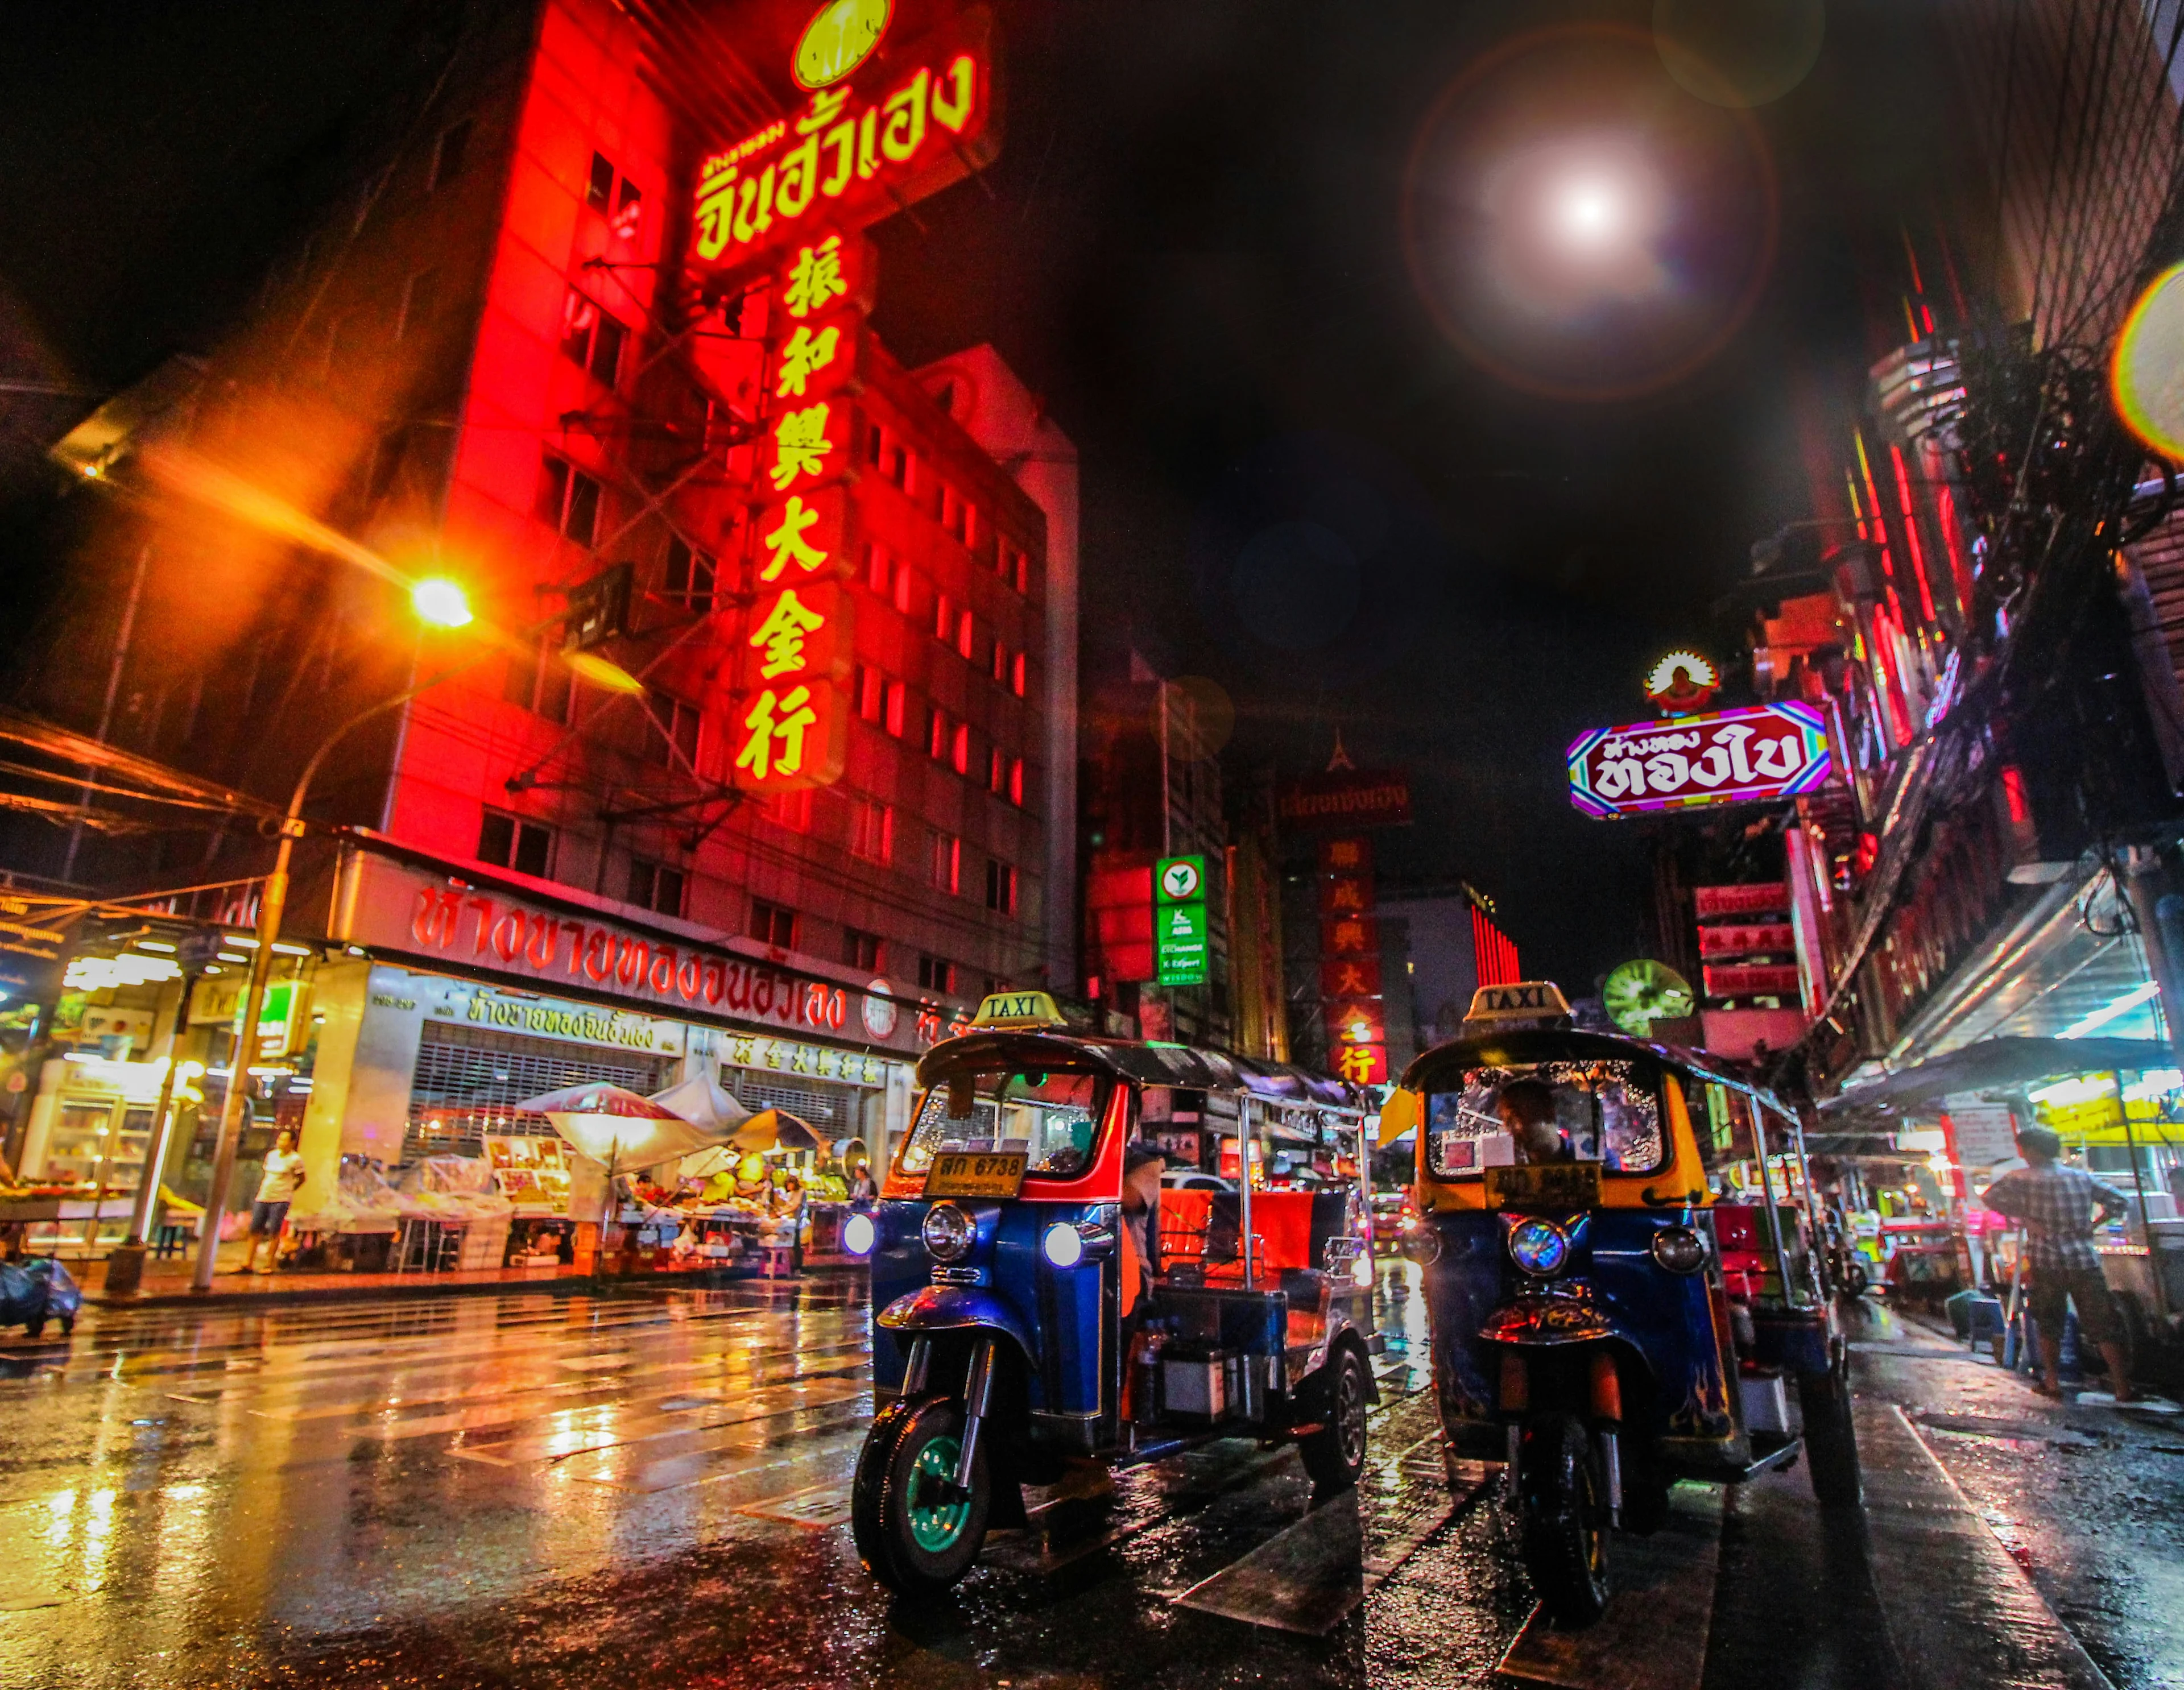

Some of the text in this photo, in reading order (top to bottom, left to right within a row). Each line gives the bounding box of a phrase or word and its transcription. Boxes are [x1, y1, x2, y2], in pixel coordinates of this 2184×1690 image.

[735, 235, 847, 780] 振和興大金行
[1595, 723, 1802, 798] ทองใบ
[987, 996, 1037, 1018] TAXI
[1482, 987, 1548, 1009] TAXI
[974, 1157, 1020, 1177] 6738
